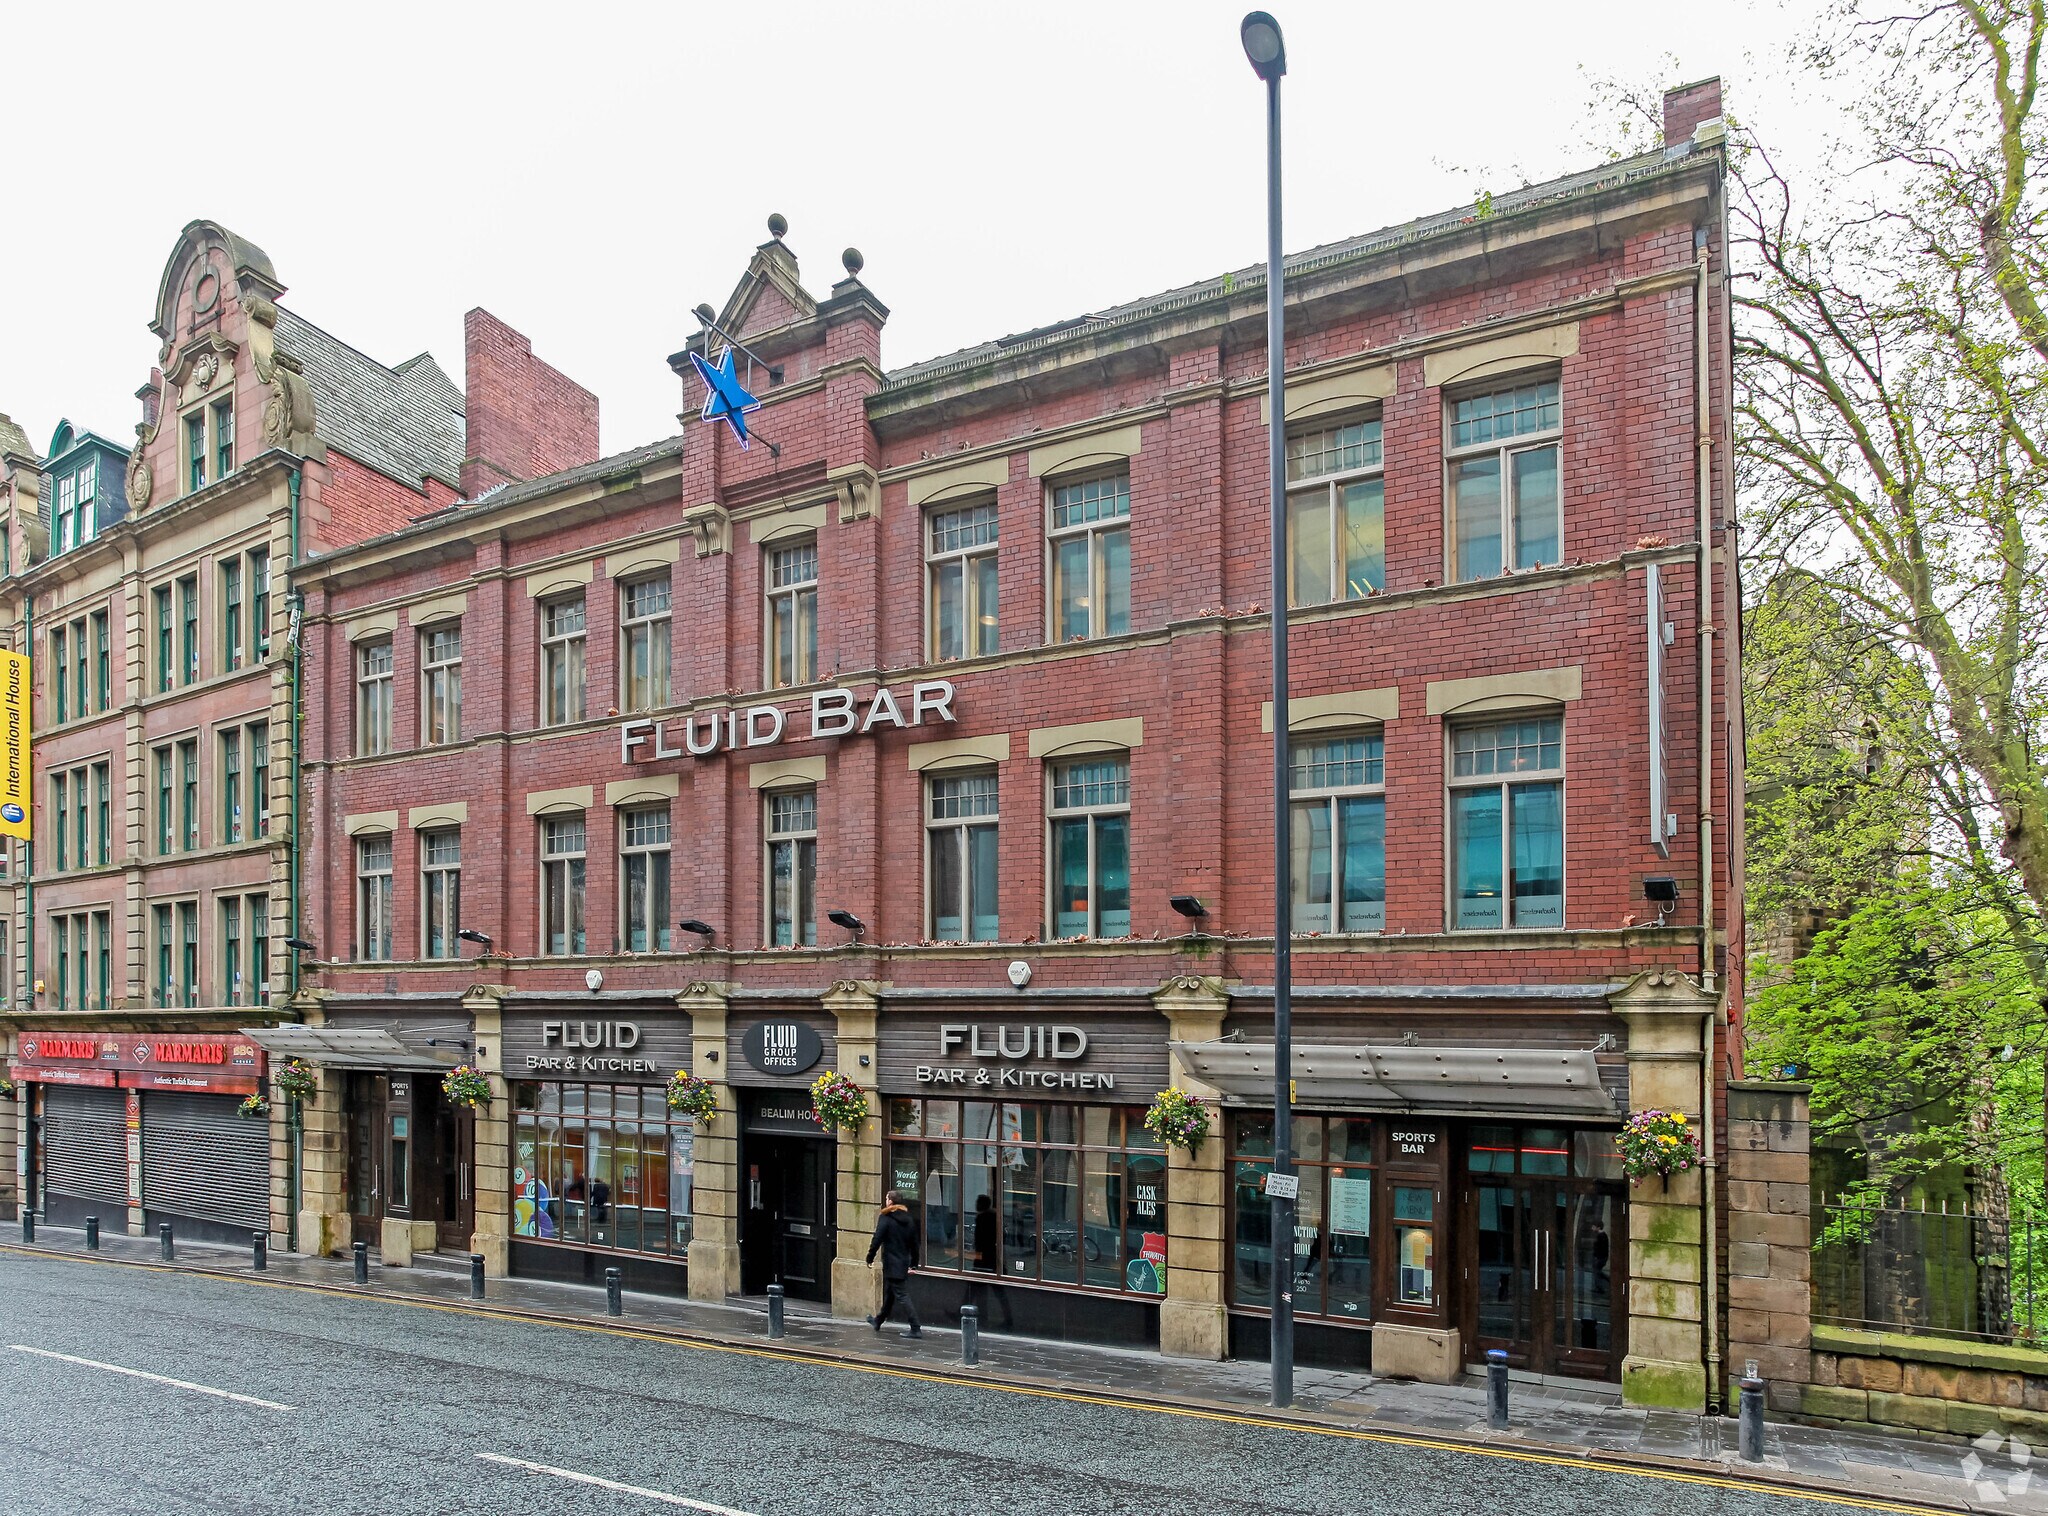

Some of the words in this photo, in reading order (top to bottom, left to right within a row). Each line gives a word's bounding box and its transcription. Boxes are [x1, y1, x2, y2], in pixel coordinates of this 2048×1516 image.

[6, 659, 20, 705] House
[621, 706, 787, 765] FLUID
[811, 680, 957, 738] BAR
[6, 707, 20, 797] International
[541, 1021, 642, 1049] FLUID
[763, 1024, 797, 1048] FLUID
[940, 1024, 1088, 1059] FLUID
[40, 1040, 97, 1059] MARMARIS
[102, 1042, 119, 1053] BBQ
[154, 1042, 227, 1065] MARMARIS
[233, 1044, 254, 1057] BBQ
[763, 1047, 797, 1057] GROUP
[564, 1055, 577, 1070] &
[763, 1057, 797, 1066] OFFICES
[974, 1067, 990, 1085] &
[761, 1108, 795, 1119] BEALIM
[1392, 1132, 1436, 1143] SPORTS
[1401, 1143, 1425, 1154] BAR
[895, 1169, 919, 1180] World
[896, 1181, 915, 1189] Beers
[1136, 1184, 1157, 1201] CASK
[1402, 1192, 1423, 1202] NEW
[1136, 1201, 1156, 1216] ALES
[1401, 1205, 1426, 1215] MENU
[1293, 1225, 1318, 1239] NCTION
[1296, 1285, 1307, 1293] 250
